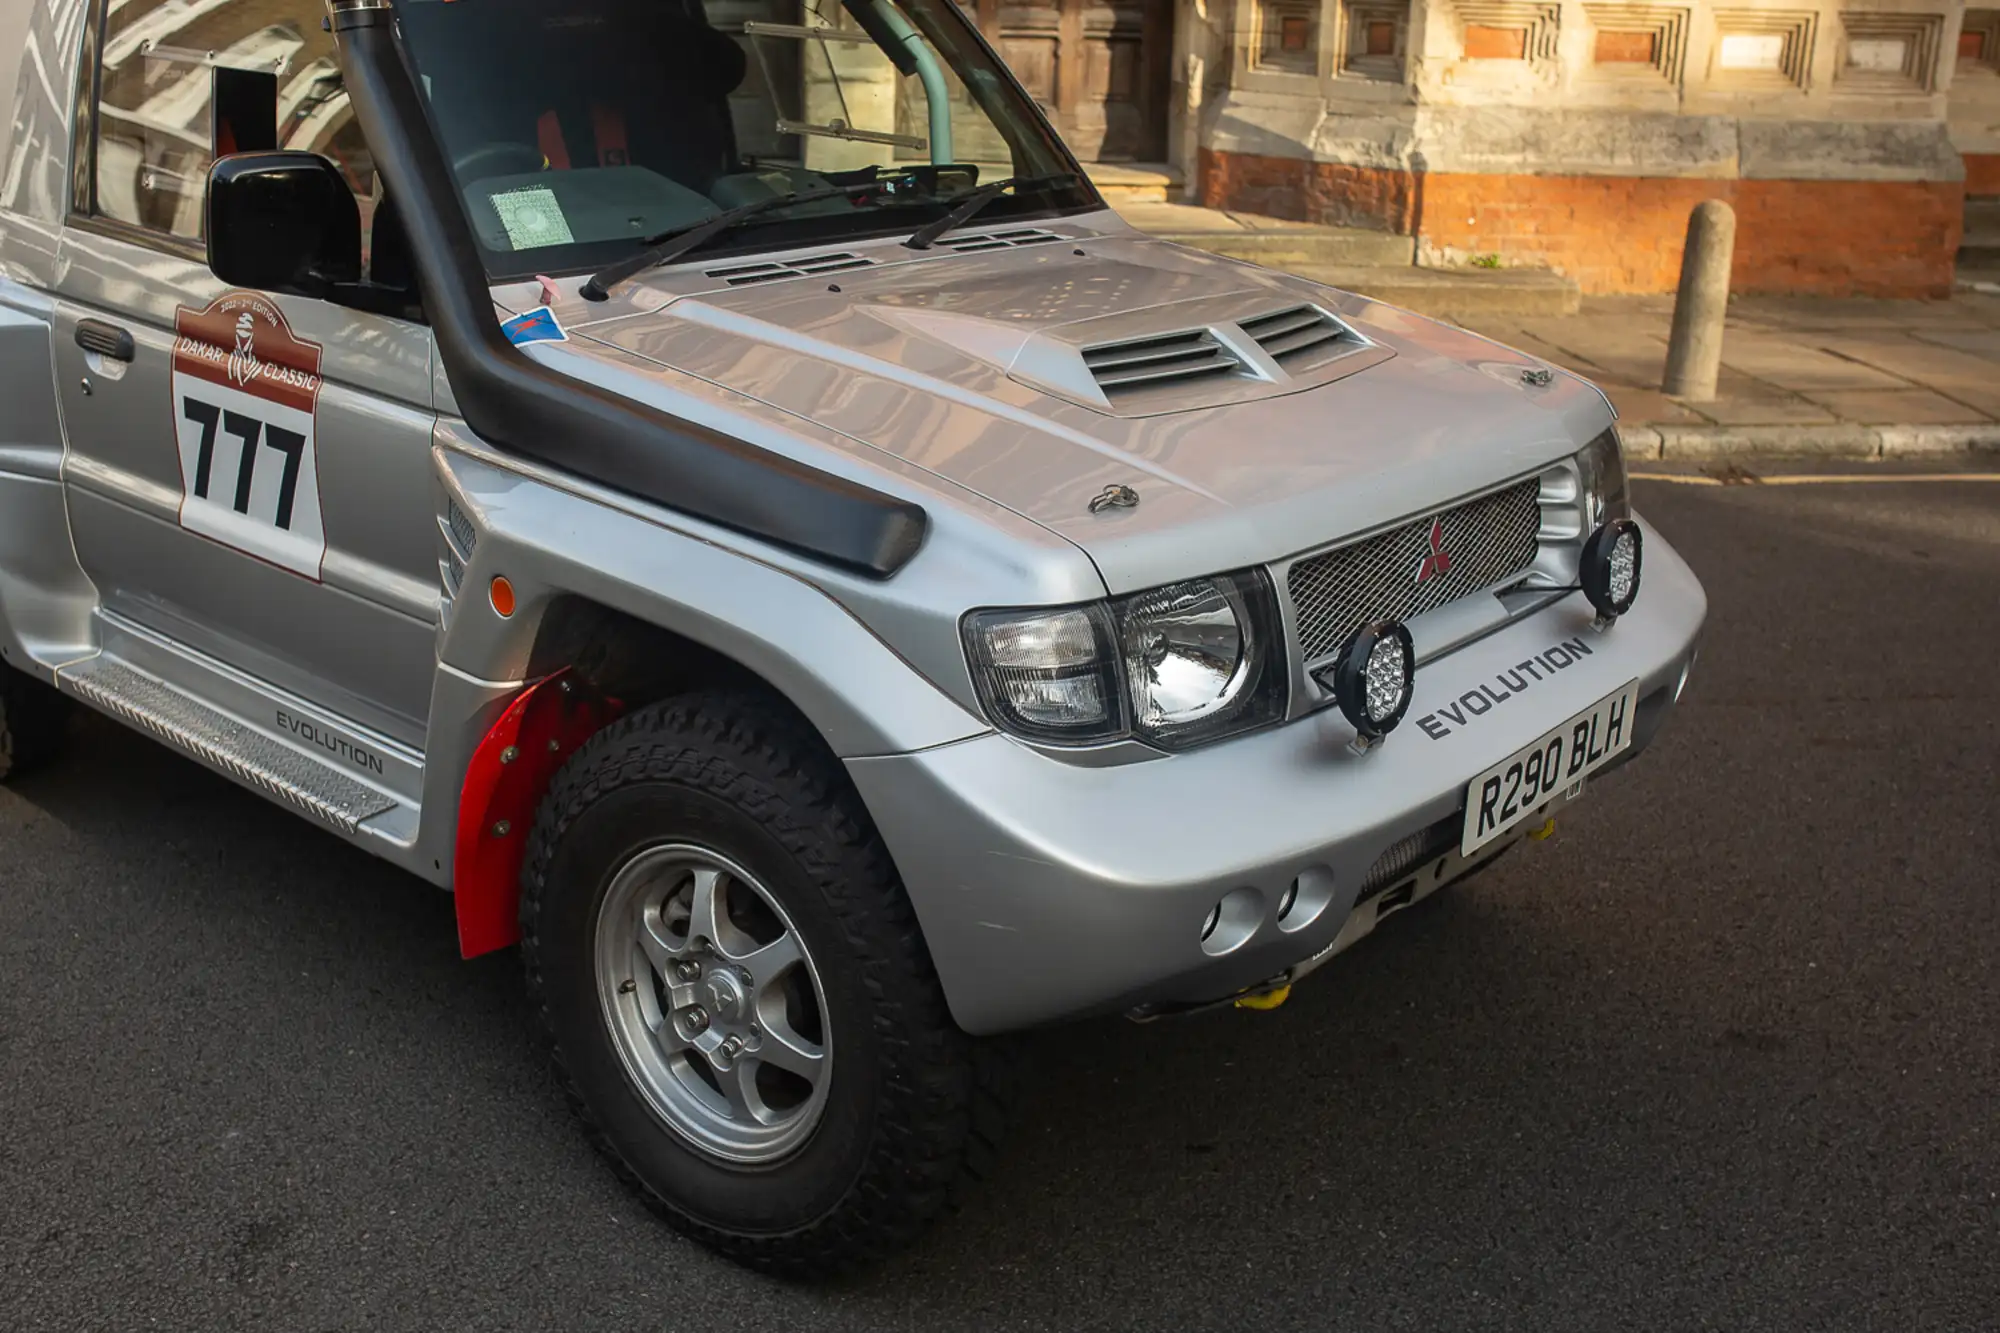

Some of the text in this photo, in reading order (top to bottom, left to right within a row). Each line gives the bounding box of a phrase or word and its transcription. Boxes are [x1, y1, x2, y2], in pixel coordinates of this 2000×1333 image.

[252, 301, 278, 328] EDITION
[180, 338, 316, 391] DAKAR CLASSIC
[183, 395, 307, 531] 777
[1415, 637, 1593, 740] EVOLUTION
[276, 710, 383, 775] EVOLUTION
[1476, 695, 1628, 839] R290 BLH
